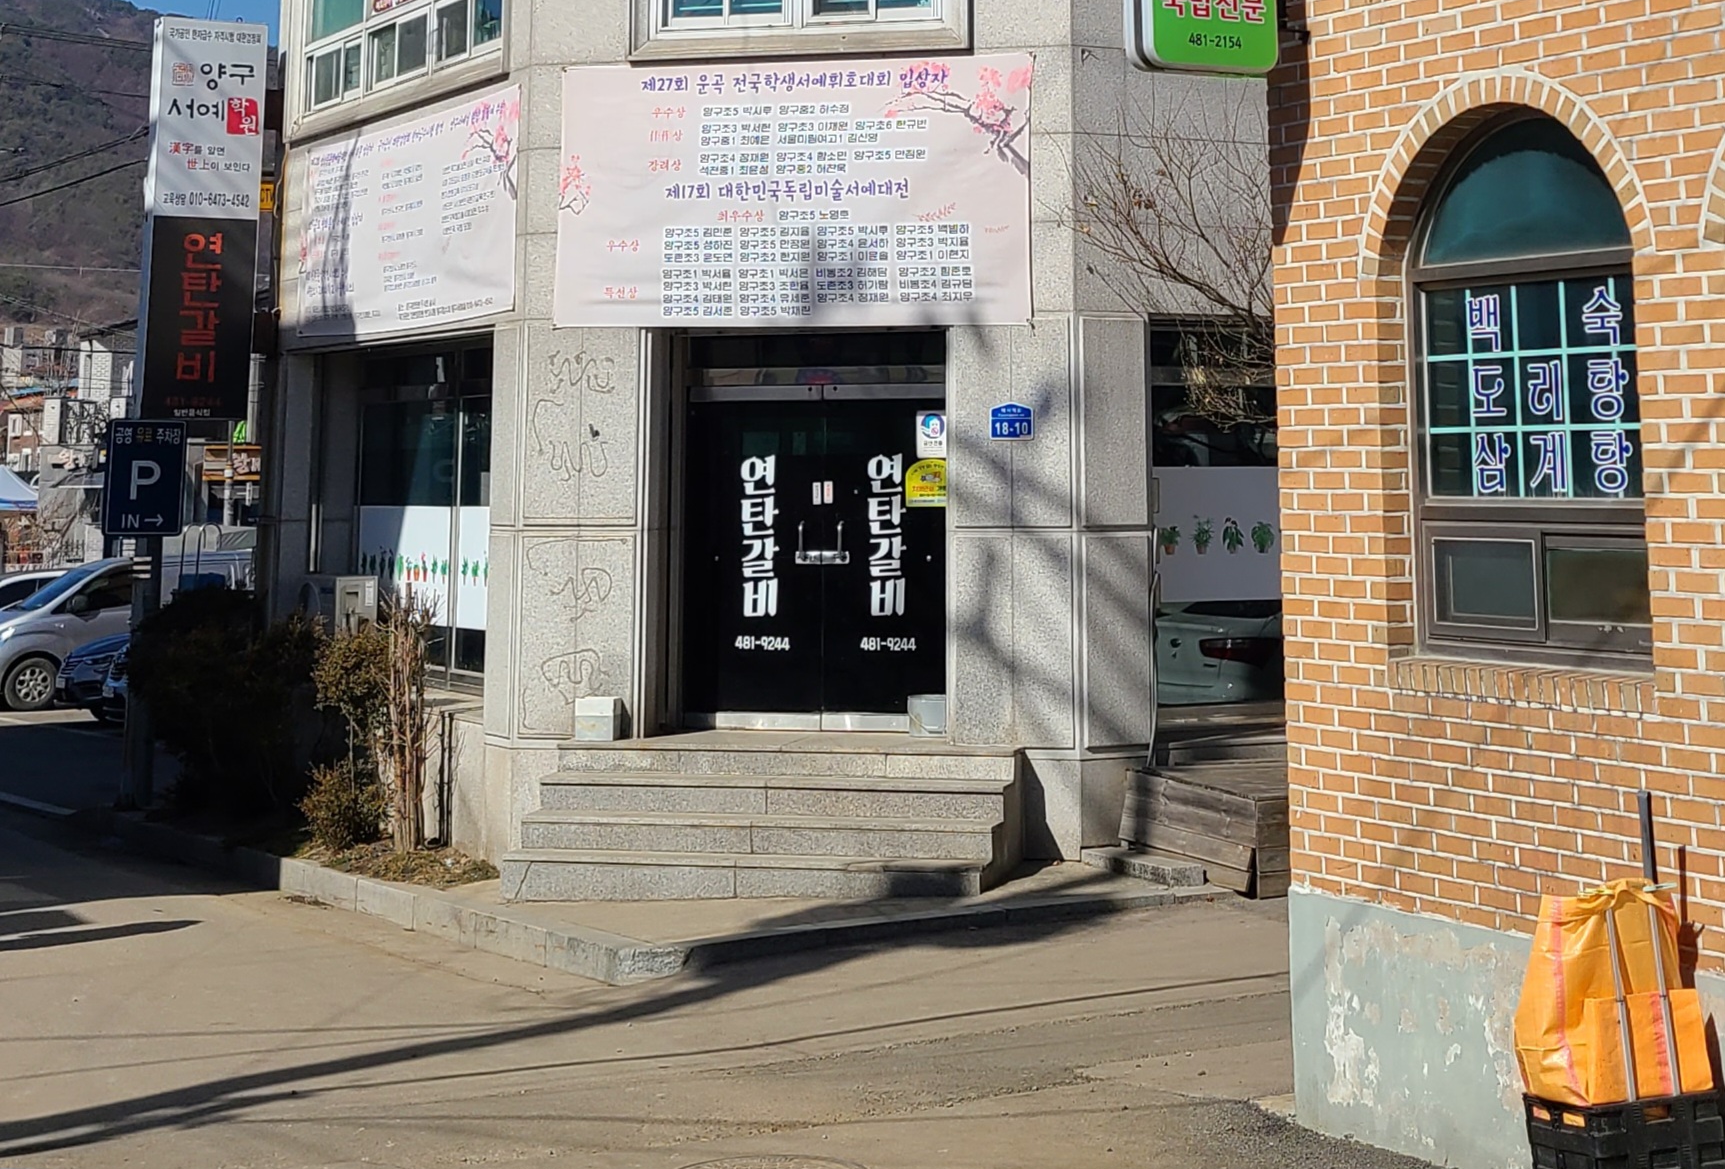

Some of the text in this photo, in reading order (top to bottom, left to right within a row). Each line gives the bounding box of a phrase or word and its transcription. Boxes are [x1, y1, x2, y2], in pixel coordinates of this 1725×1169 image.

[1188, 32, 1242, 50] 481-2154
[200, 63, 255, 91] 양구
[642, 68, 949, 94] 제27회 운곡 전국학생서예휘호대회 입상자
[167, 98, 225, 122] 서예
[229, 97, 259, 136] 학원
[223, 162, 250, 173] 보인다
[189, 191, 250, 208] 010-6473-4542
[666, 178, 908, 202] 제17회 대한민국독립미술서예대전
[716, 210, 765, 223] 최우수상
[606, 239, 640, 252] 우수상
[177, 233, 224, 384] 연탄갈비
[1472, 358, 1630, 422] 도리탕
[115, 427, 133, 444] 공영
[156, 428, 182, 445] 주차장
[995, 422, 1028, 436] 18-10
[1474, 429, 1634, 494] 삼계탕
[129, 460, 161, 501] P
[121, 514, 140, 529] IN
[739, 454, 780, 618] 연탄갈비
[867, 453, 907, 618] 연탄갈비
[734, 635, 791, 652] 481-9244
[860, 636, 917, 652] 481-9244
